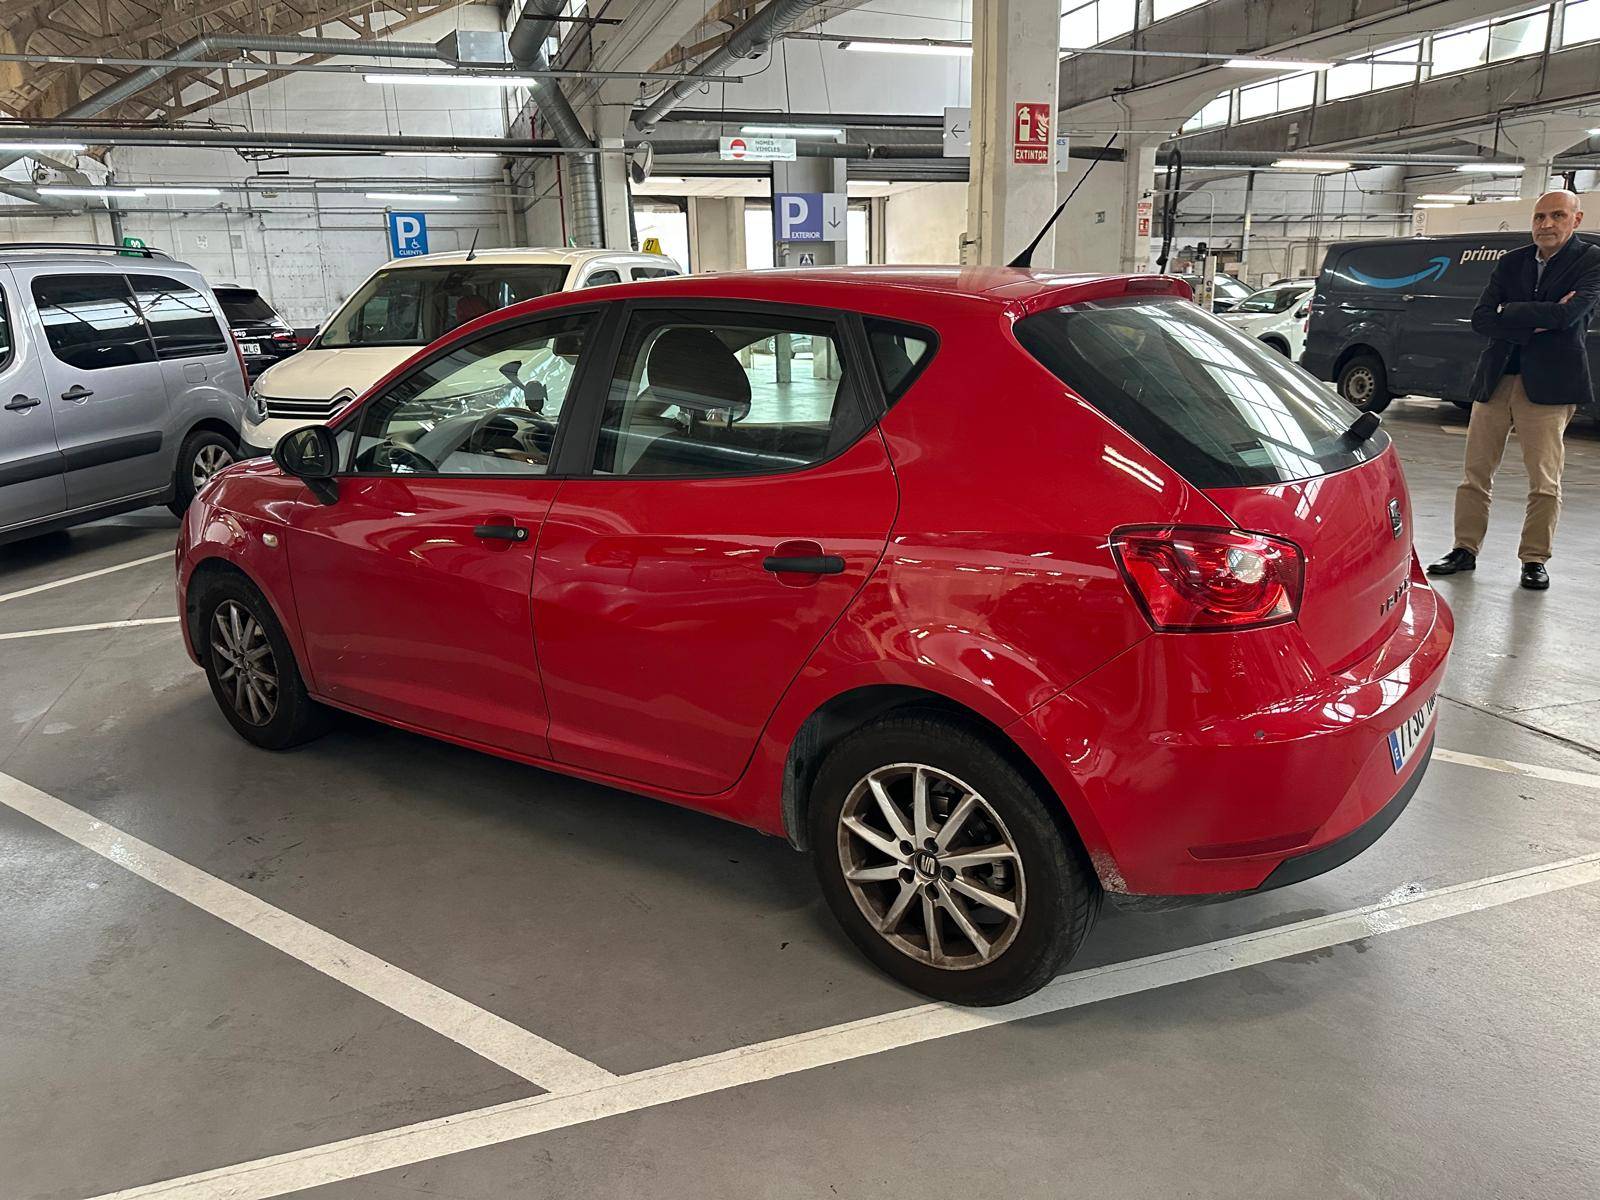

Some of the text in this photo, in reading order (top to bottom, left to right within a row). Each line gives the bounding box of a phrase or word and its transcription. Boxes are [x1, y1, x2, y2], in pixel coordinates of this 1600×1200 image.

[1016, 149, 1047, 160] EXTINTOR
[781, 196, 808, 238] P
[396, 216, 420, 249] P
[791, 231, 820, 239] EXTERIOR
[645, 240, 654, 250] 27
[1460, 246, 1507, 264] prime
